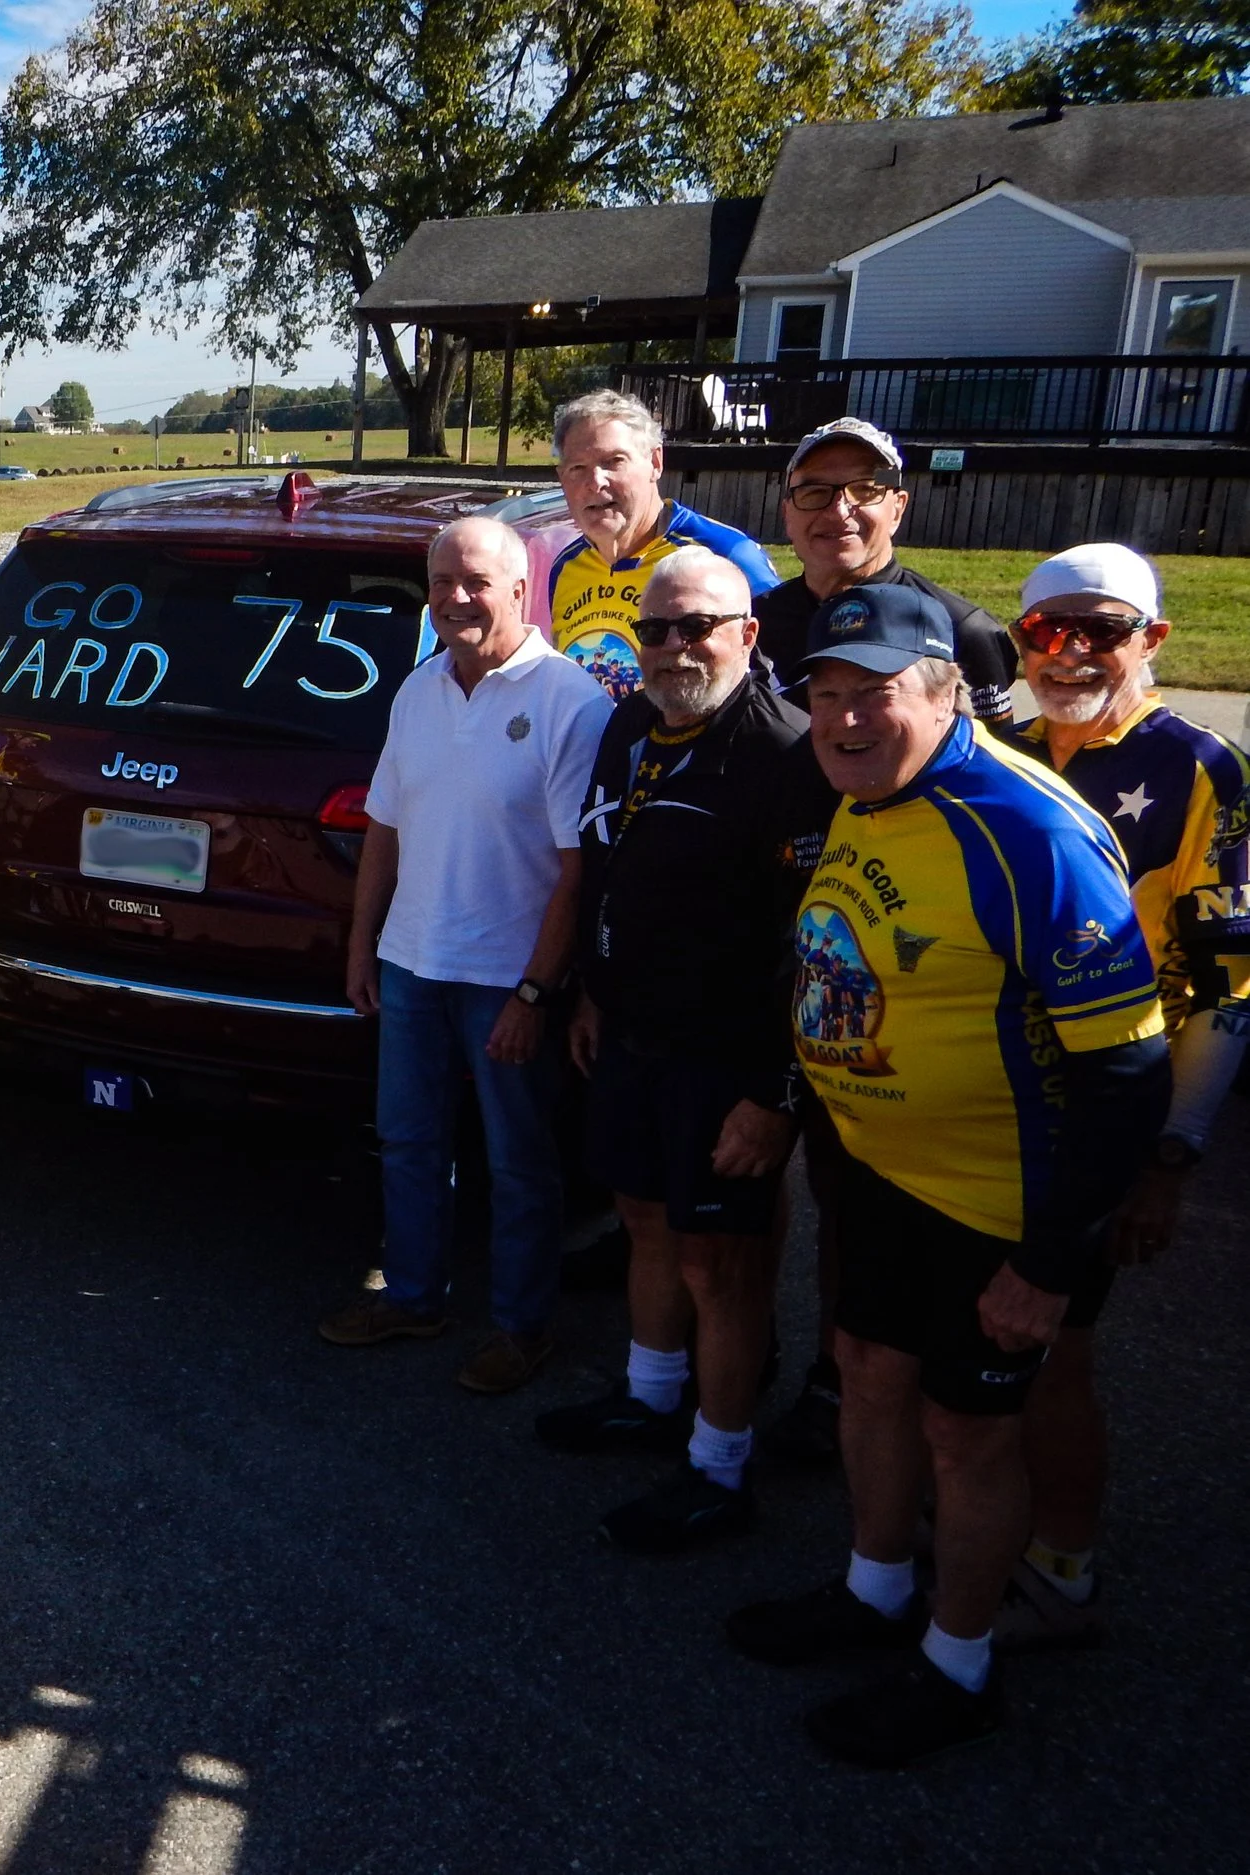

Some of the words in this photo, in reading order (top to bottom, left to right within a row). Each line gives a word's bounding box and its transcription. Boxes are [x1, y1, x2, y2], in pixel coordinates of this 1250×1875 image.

[24, 581, 142, 630] GO
[562, 587, 593, 620] Gulf
[597, 584, 615, 599] to
[620, 585, 642, 607] Go
[565, 610, 601, 633] CHARITY
[601, 610, 625, 621] BIKE
[233, 595, 392, 699] 75
[101, 751, 179, 789] Jeep
[115, 815, 174, 832] VIRGINIA
[862, 858, 907, 916] Goat
[857, 898, 881, 929] RIDE
[601, 923, 610, 958] CURE
[1057, 971, 1083, 987] Gulf
[1089, 969, 1103, 979] to
[1108, 958, 1135, 974] Goat
[817, 1044, 864, 1062] GOAT
[93, 1080, 117, 1107] N
[838, 1079, 907, 1102] ACADEMY
